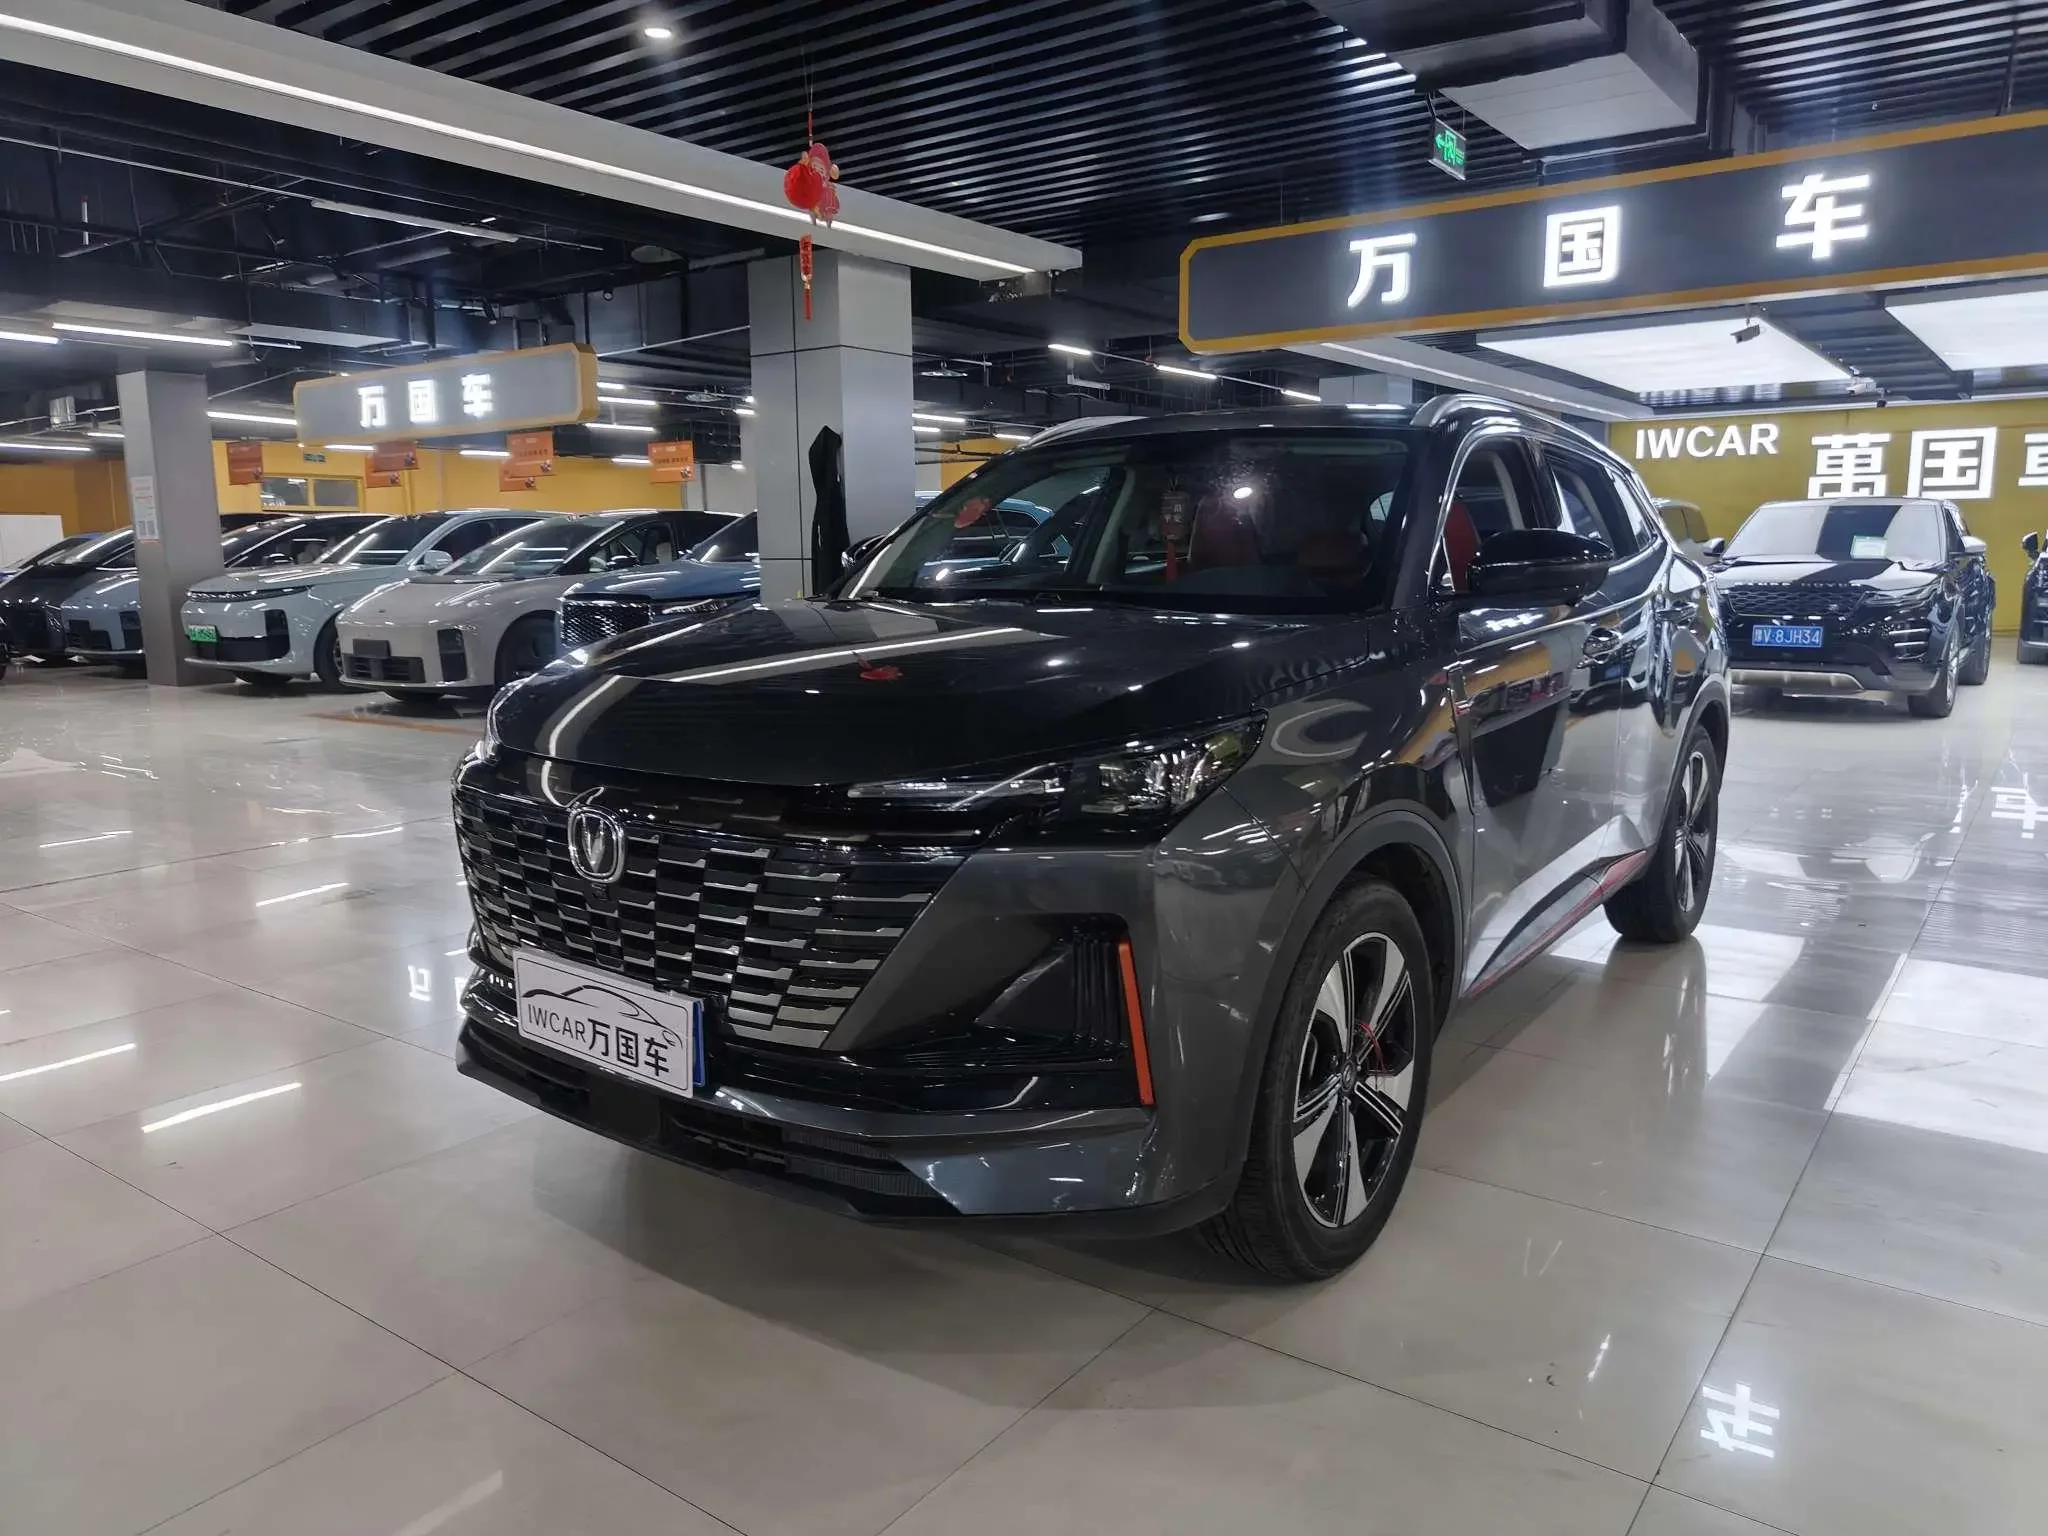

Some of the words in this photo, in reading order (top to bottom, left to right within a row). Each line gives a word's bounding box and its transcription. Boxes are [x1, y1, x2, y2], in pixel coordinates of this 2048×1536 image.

[1347, 173, 1870, 307] 万国车
[1635, 423, 1779, 459] IWCAR
